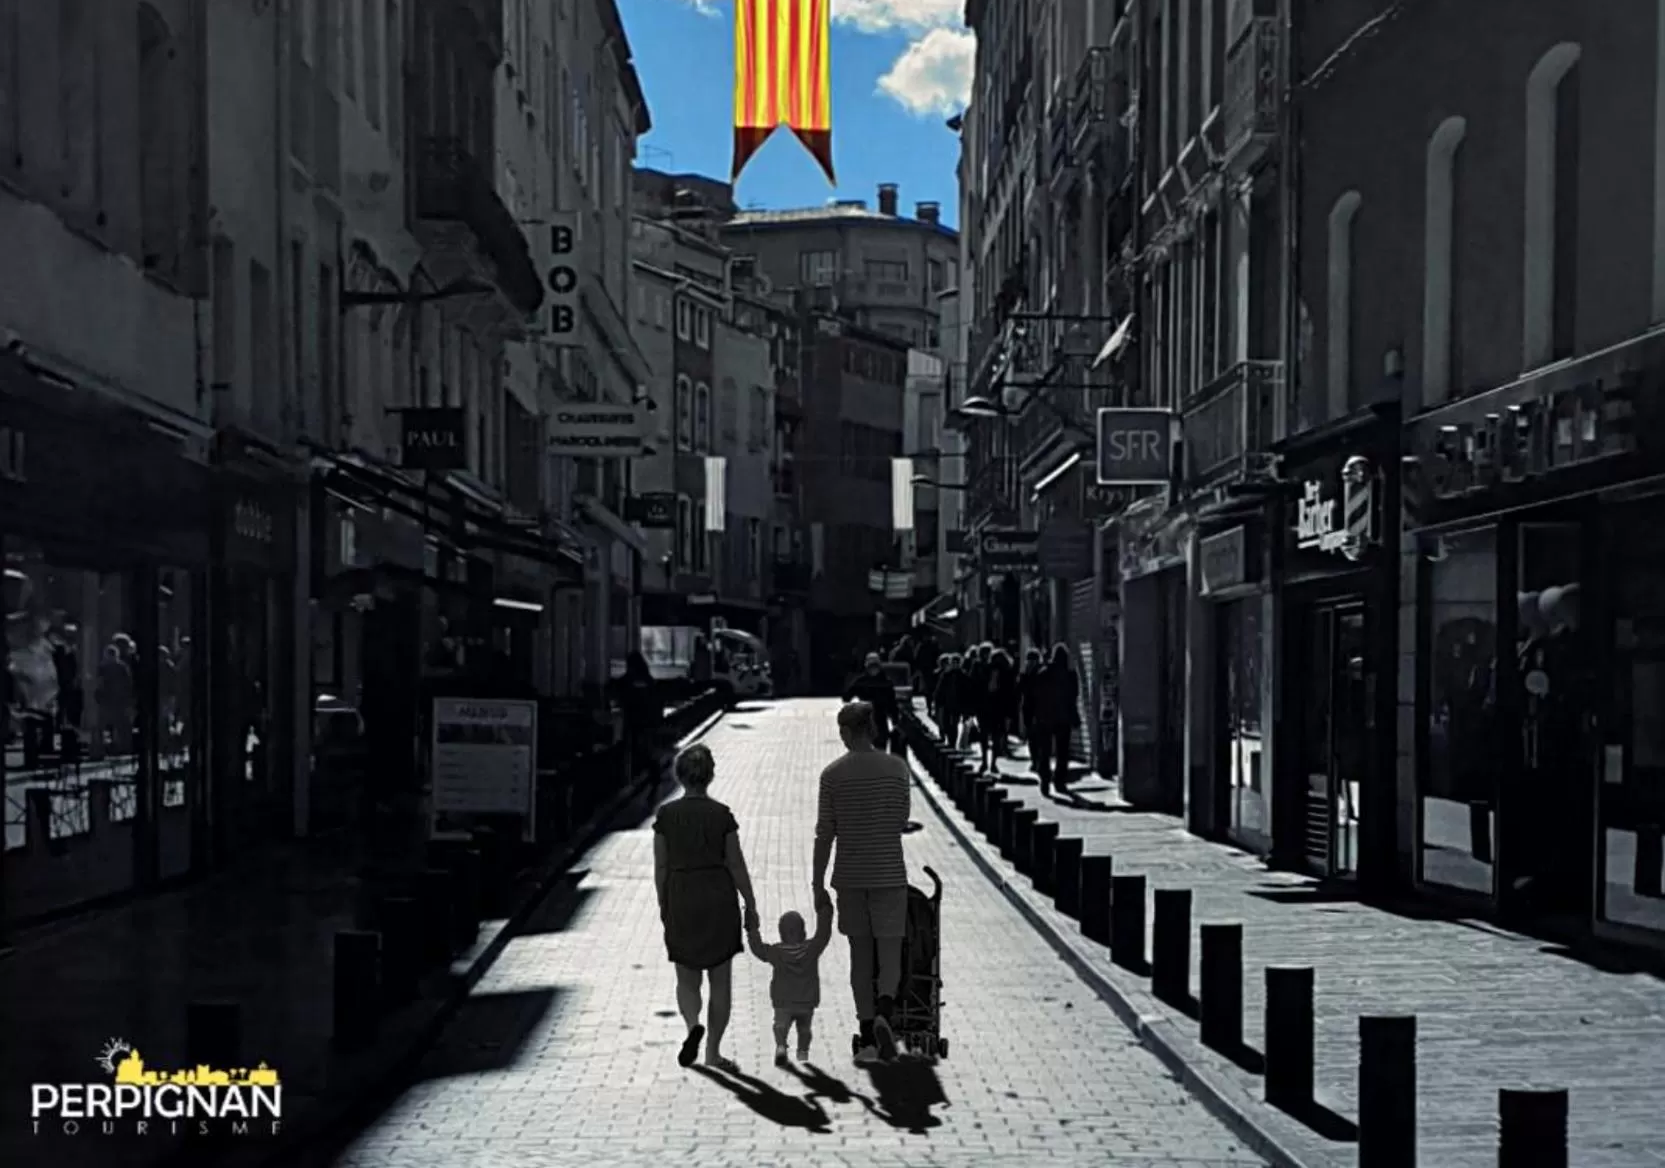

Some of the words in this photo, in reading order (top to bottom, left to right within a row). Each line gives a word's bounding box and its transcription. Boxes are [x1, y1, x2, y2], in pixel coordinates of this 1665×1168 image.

[550, 225, 577, 333] BOB
[406, 429, 457, 448] PAUL
[1109, 430, 1161, 461] SFR
[1085, 483, 1124, 505] Krys
